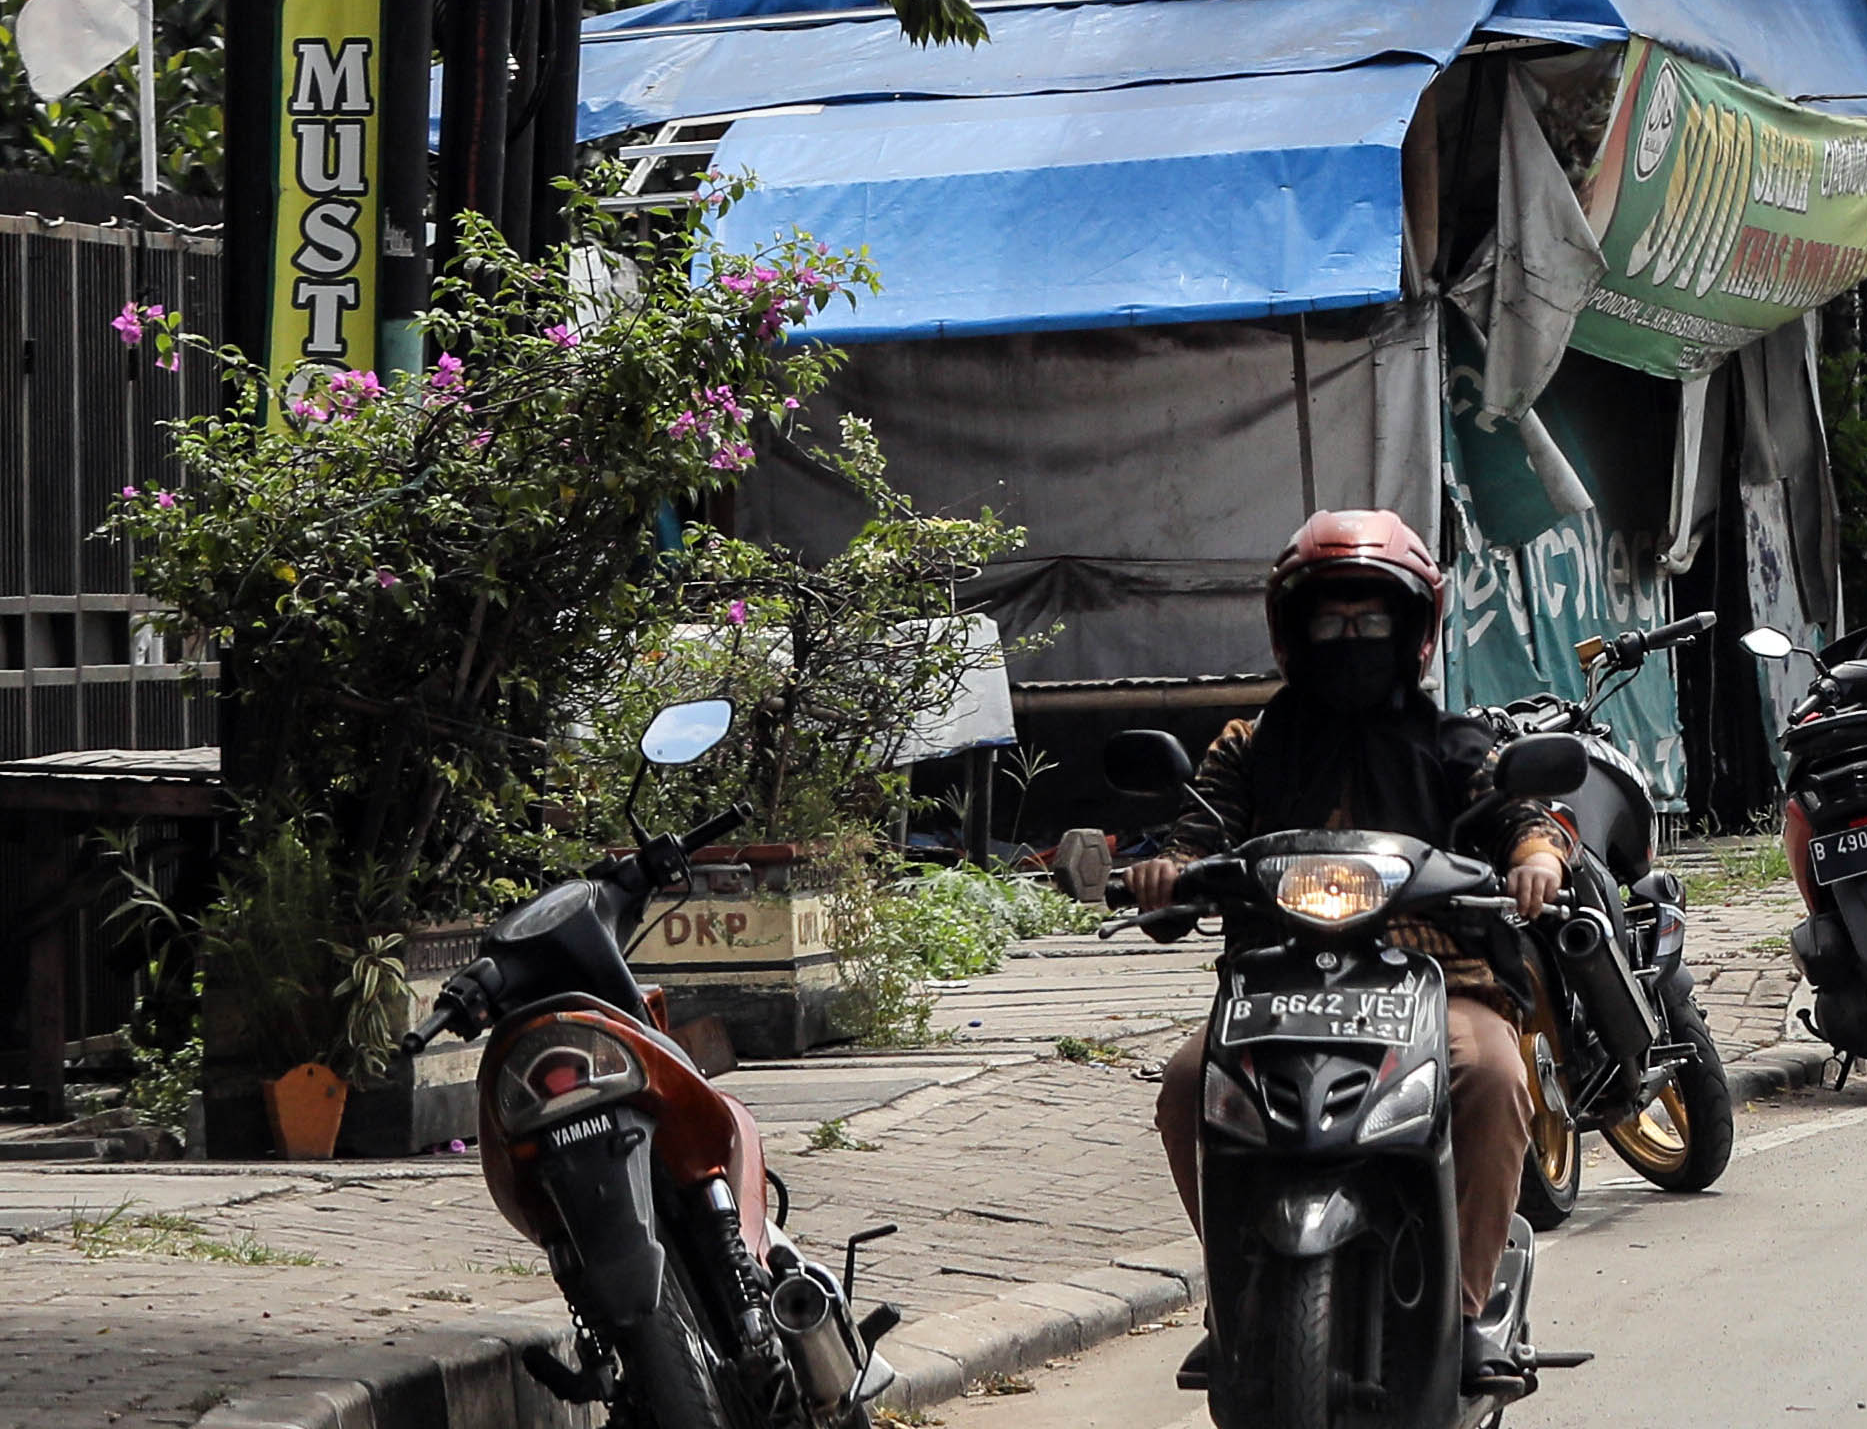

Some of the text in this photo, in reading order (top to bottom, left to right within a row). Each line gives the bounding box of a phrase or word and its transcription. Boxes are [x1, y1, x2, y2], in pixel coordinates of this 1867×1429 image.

[1813, 843, 1825, 861] B
[664, 912, 747, 946] DKP
[1233, 1002, 1250, 1018] B
[1271, 994, 1342, 1016] 6642
[551, 1114, 612, 1147] YAMAHA
